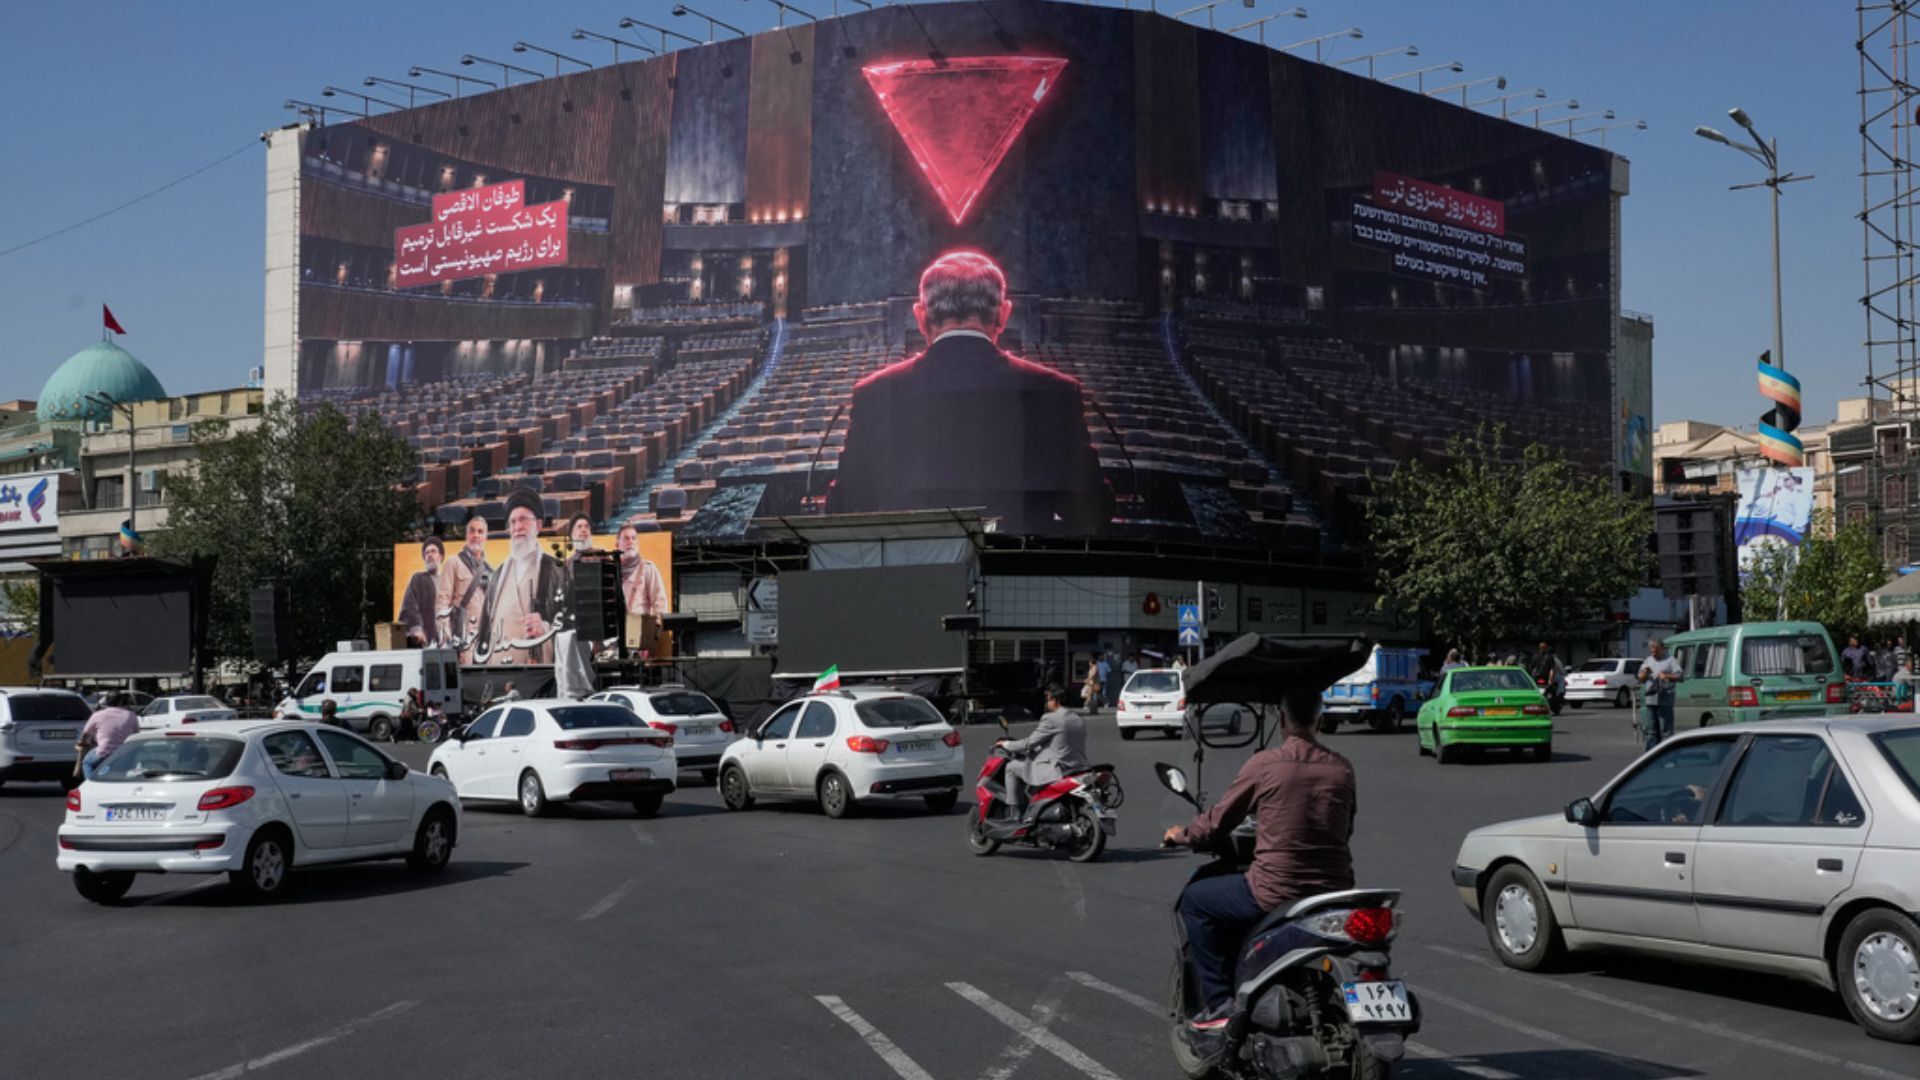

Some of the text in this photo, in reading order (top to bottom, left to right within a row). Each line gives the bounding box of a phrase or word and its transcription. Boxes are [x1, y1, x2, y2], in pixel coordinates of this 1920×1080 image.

[438, 186, 520, 221] طوفان الاقصی
[1405, 185, 1445, 212] منزوی
[1445, 195, 1464, 221] روز
[486, 211, 533, 234] شکست
[535, 206, 557, 227] یک
[1465, 201, 1478, 225] به
[1478, 204, 1497, 229] روز
[401, 229, 434, 257] ترمیم
[1354, 224, 1373, 239] כבר
[400, 235, 561, 277] برای رژیم صهیونیستی است
